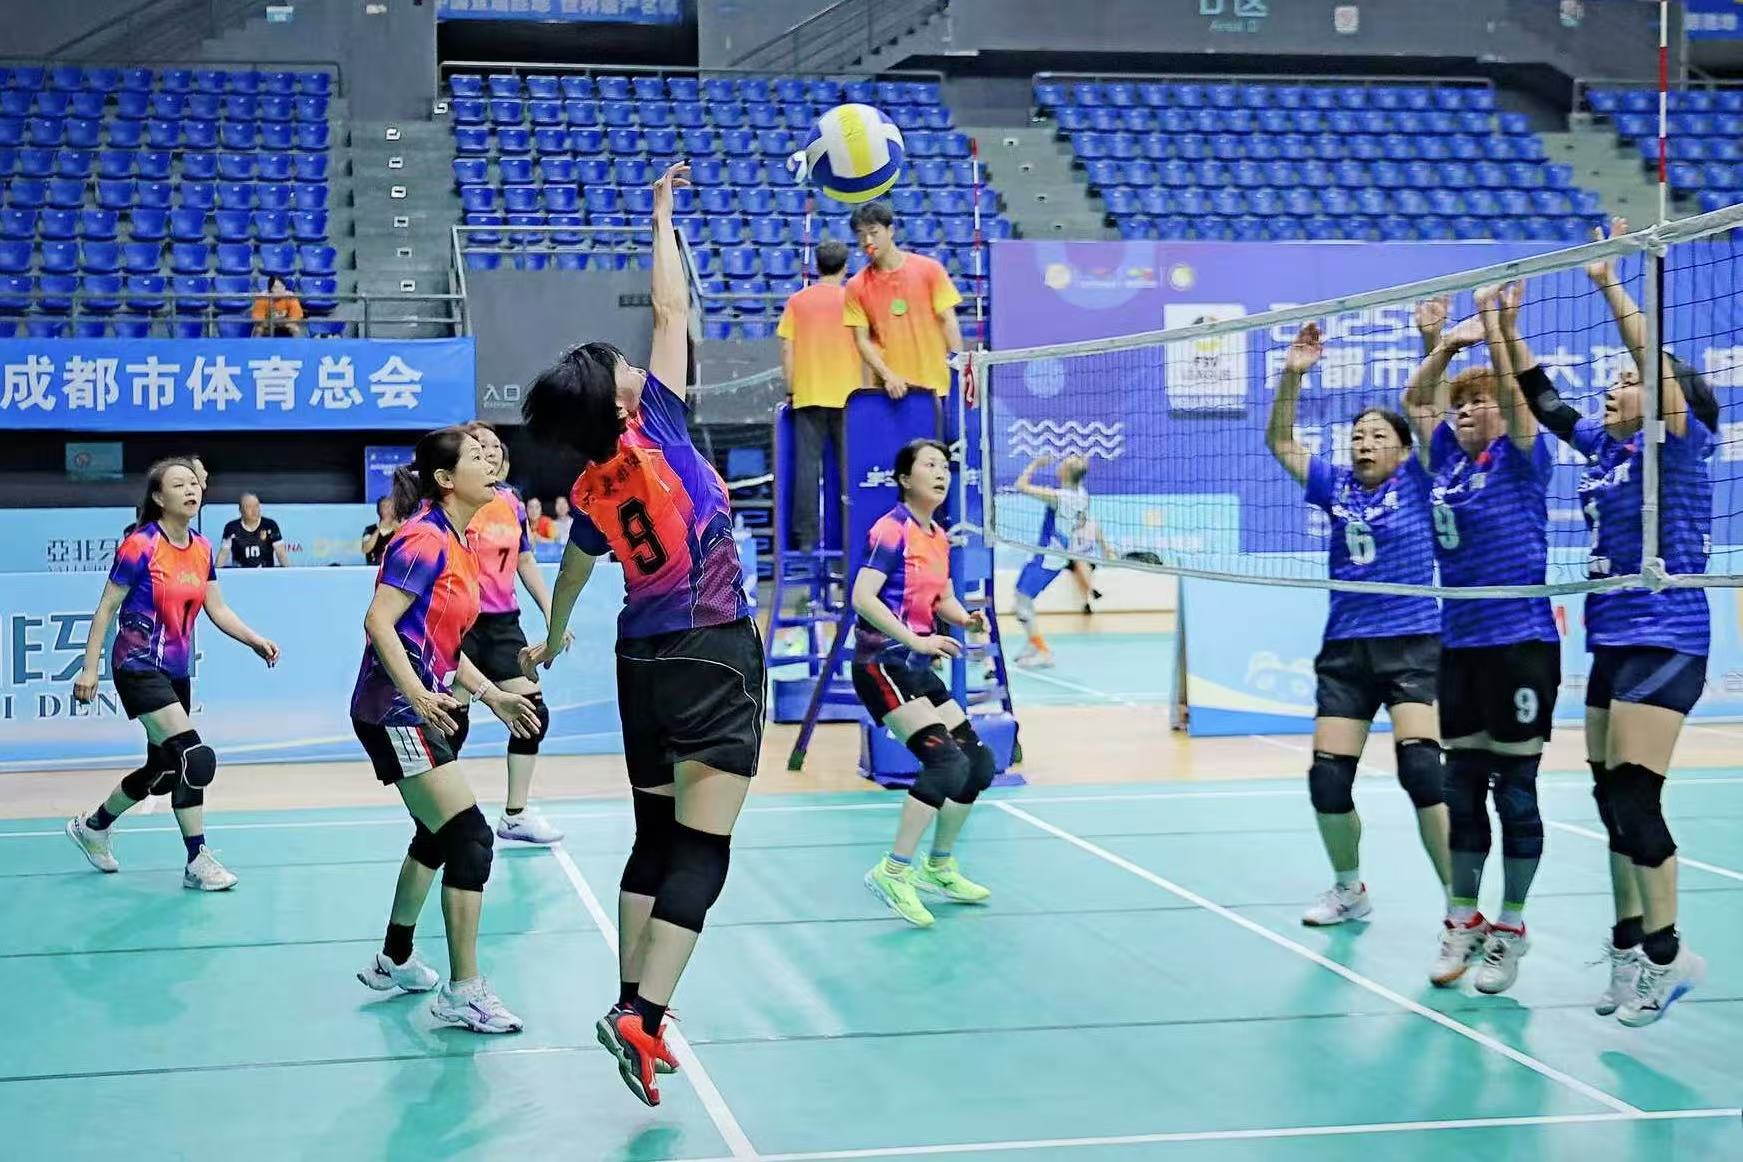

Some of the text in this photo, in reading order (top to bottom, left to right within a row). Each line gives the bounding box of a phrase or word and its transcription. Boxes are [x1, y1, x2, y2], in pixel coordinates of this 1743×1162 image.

[0, 355, 424, 412] 成都市体育总会
[483, 383, 521, 401] 入口
[617, 497, 670, 576] 9
[1345, 521, 1377, 566] 6
[1434, 504, 1461, 550] 9
[244, 545, 260, 558] 10
[498, 547, 510, 573] 7
[1513, 687, 1539, 724] 9
